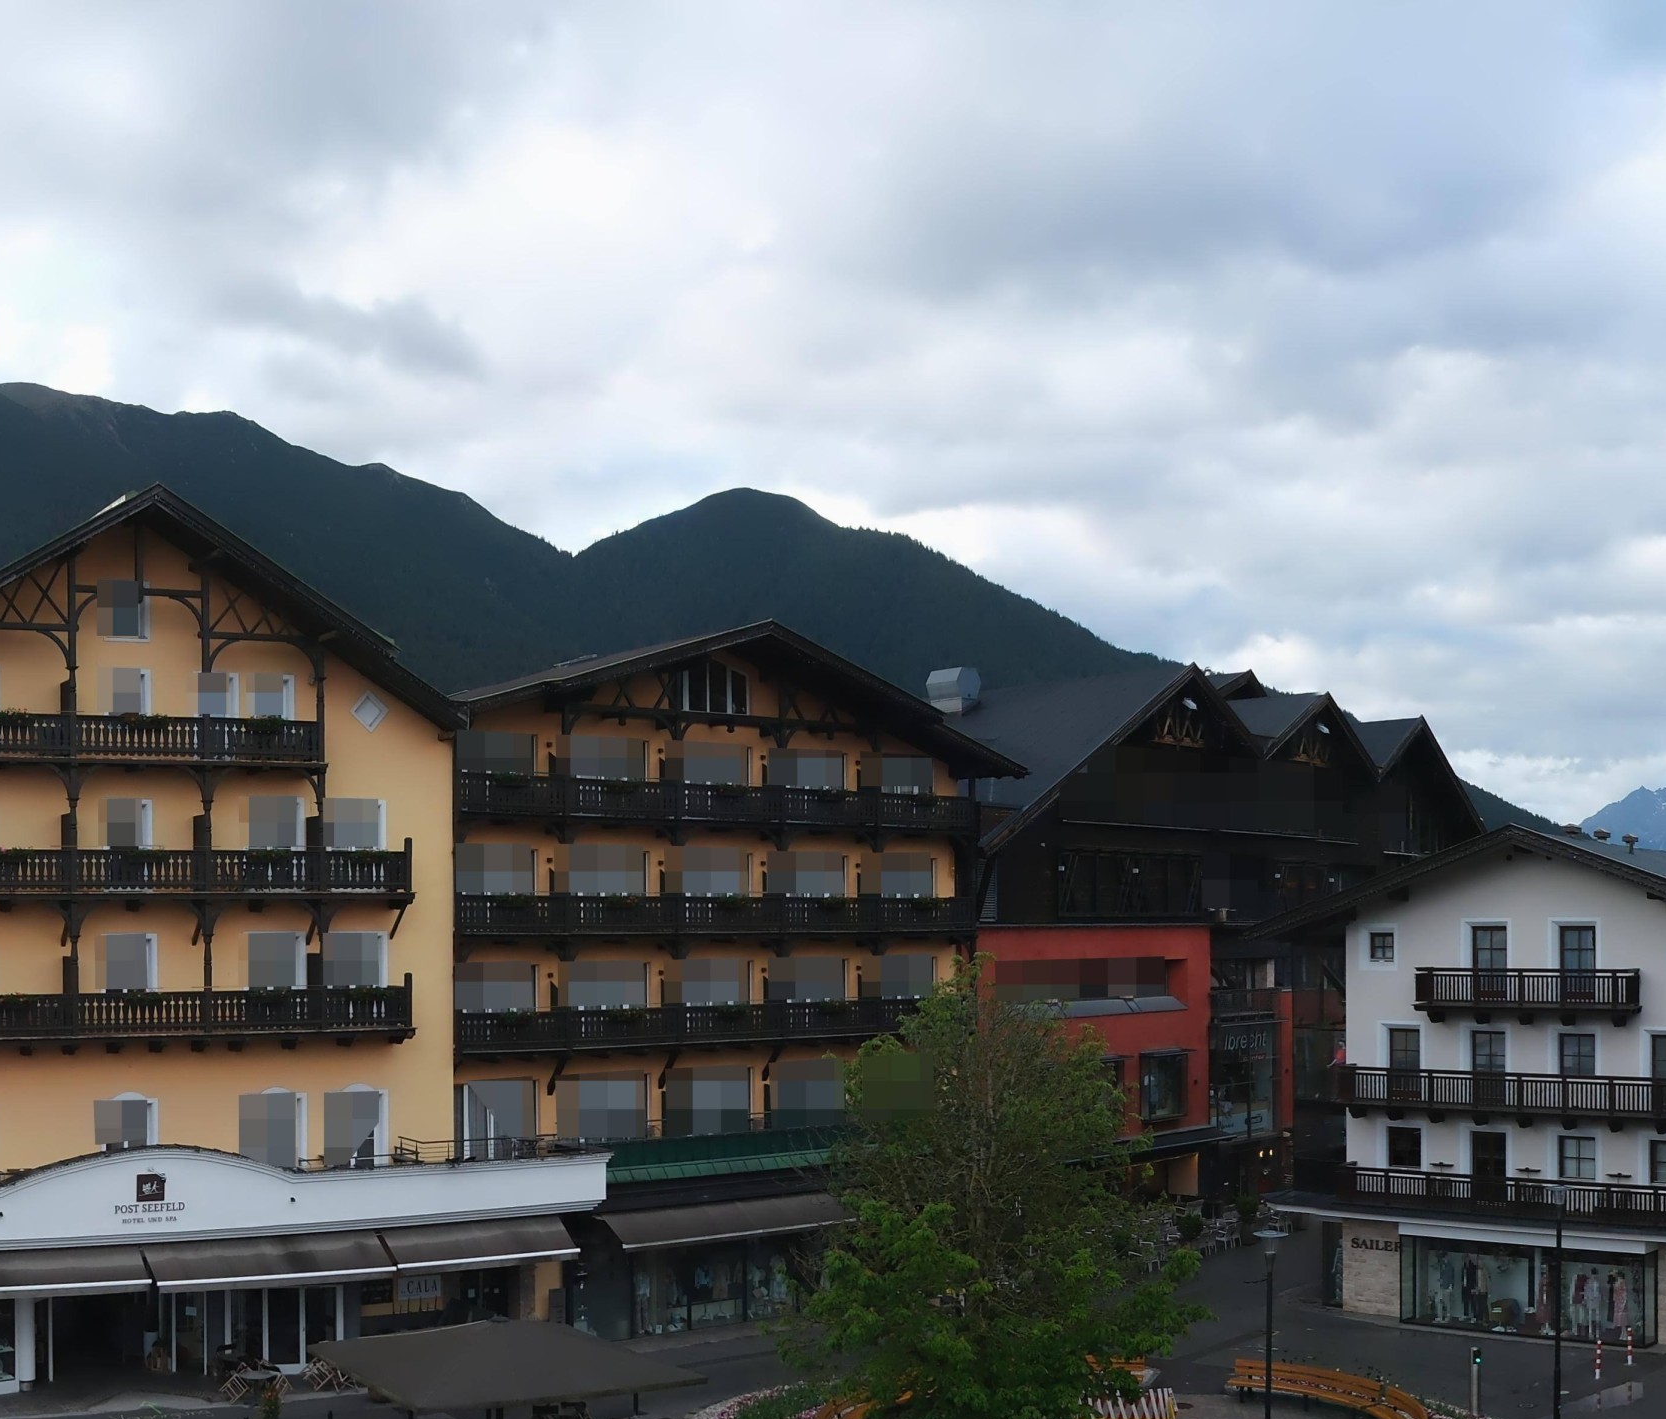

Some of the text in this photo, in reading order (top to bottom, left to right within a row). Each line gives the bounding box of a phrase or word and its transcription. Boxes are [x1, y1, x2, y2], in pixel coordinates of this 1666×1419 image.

[114, 1202, 185, 1214] POST SEEFELD
[1351, 1237, 1401, 1252] SAILER
